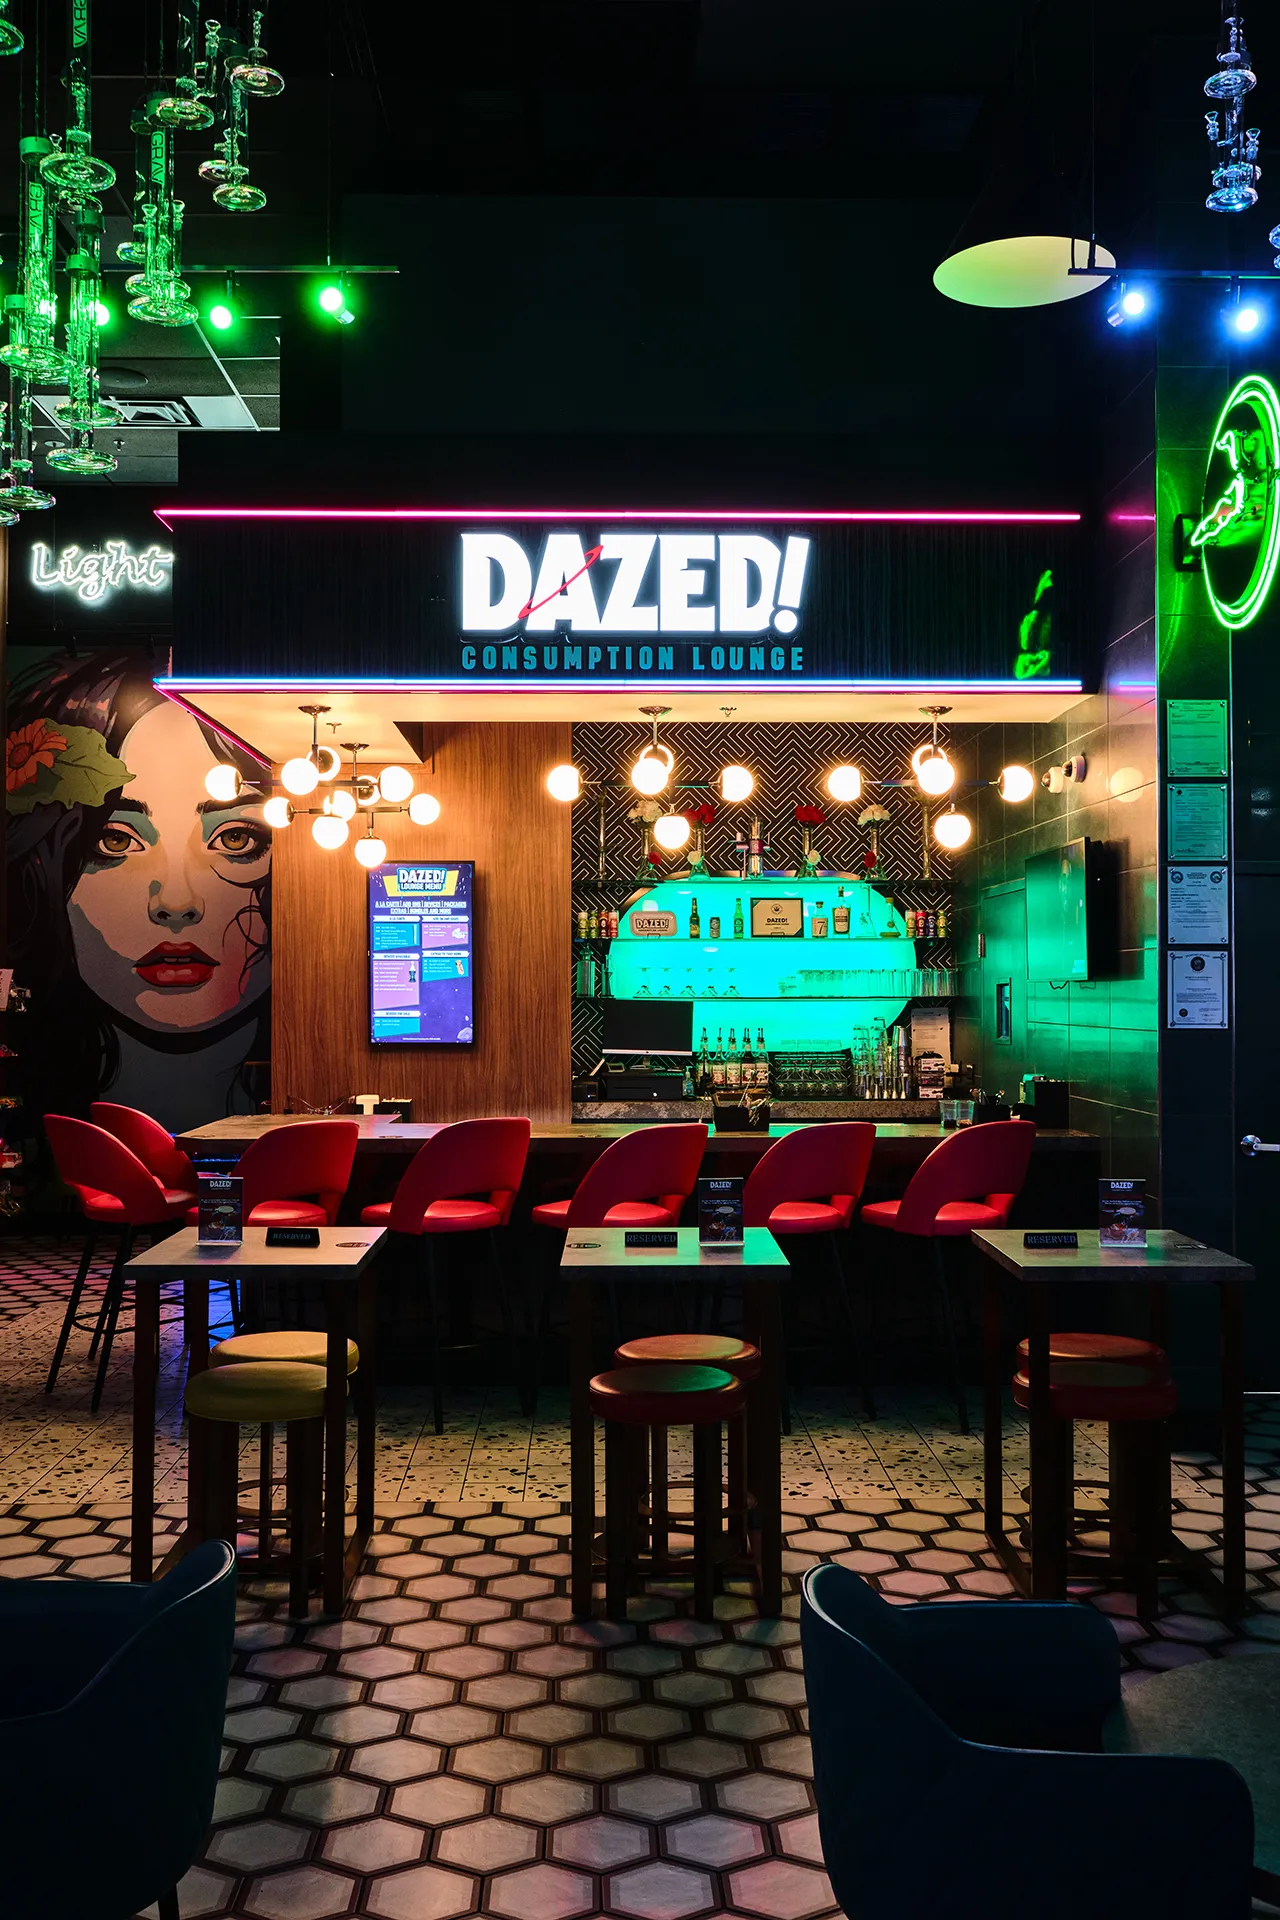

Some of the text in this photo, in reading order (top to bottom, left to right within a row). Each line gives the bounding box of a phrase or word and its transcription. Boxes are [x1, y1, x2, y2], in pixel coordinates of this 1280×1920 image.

[151, 131, 165, 185] GRAV
[32, 541, 174, 600] Light
[460, 533, 810, 633] DAZED!
[461, 646, 803, 671] CONSUMPTION LOUNGE
[399, 869, 446, 882] DAZED!
[635, 918, 669, 929] DAZED!
[817, 921, 825, 934] 7
[626, 1234, 677, 1243] RESERVED
[1027, 1235, 1077, 1244] RESERVED
